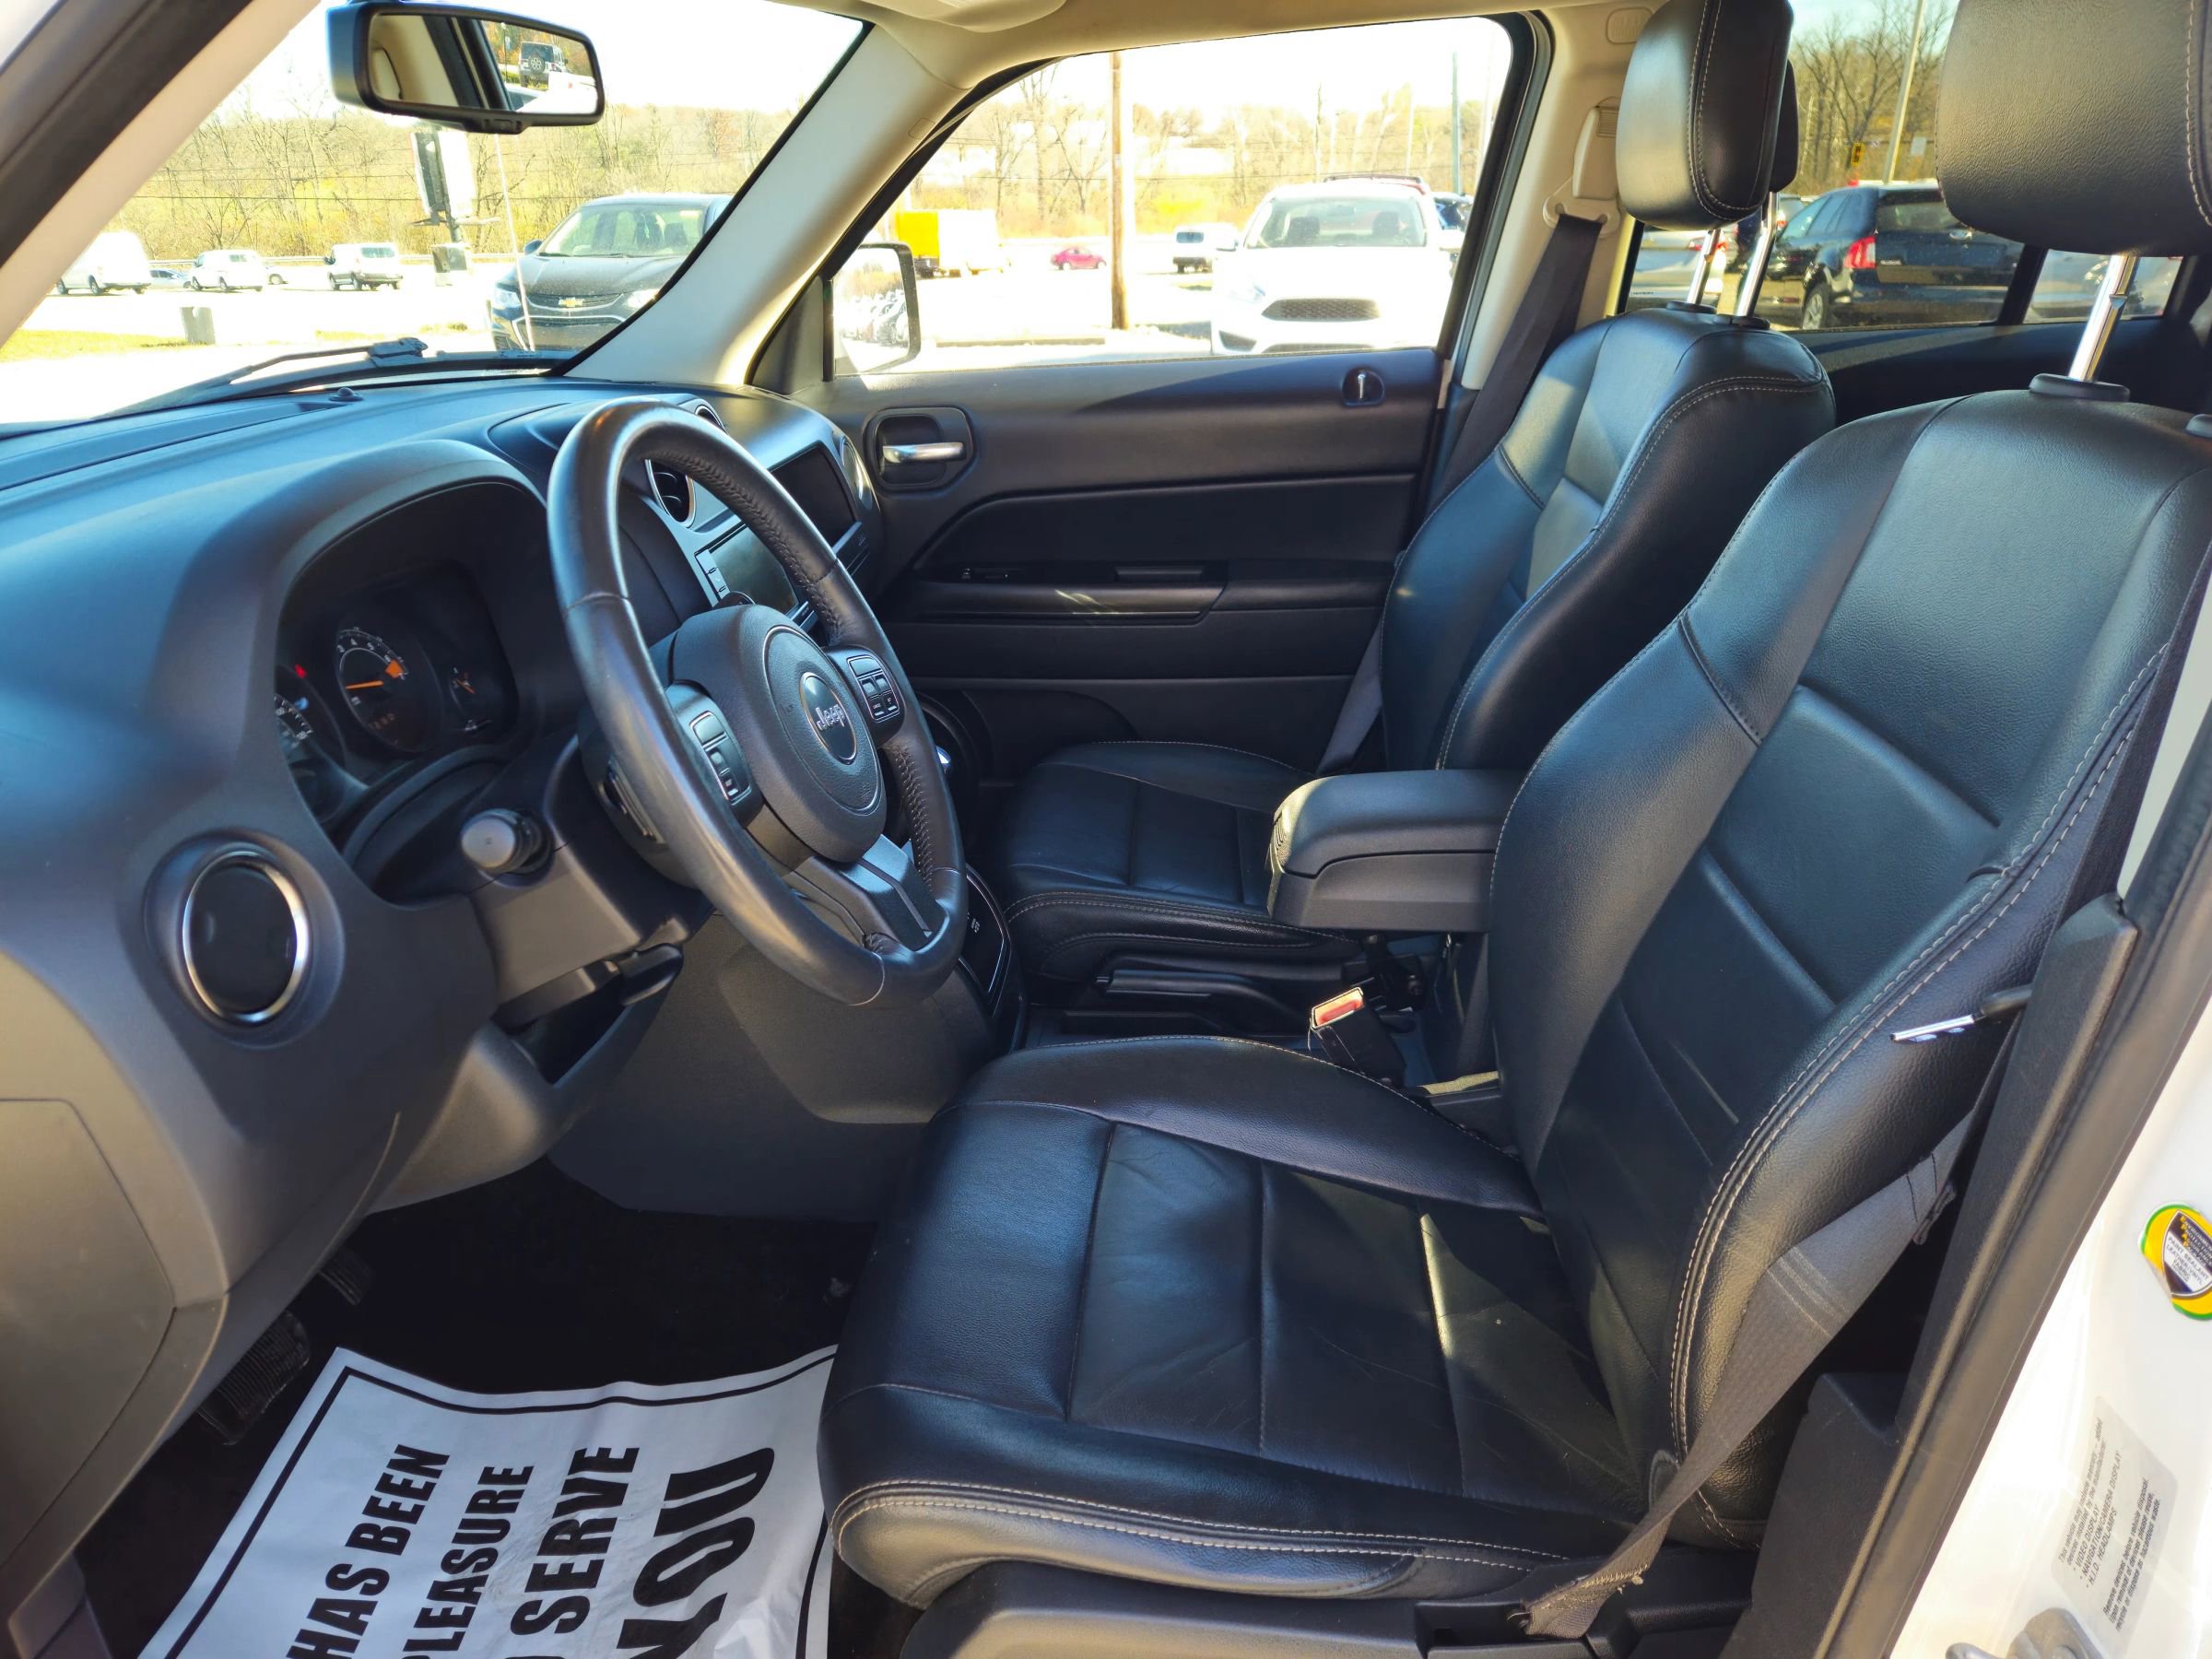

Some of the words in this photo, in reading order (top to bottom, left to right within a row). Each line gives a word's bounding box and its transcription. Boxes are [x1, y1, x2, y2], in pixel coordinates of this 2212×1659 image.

[816, 704, 846, 731] Jeep
[286, 1563, 391, 1659] HAS
[344, 1443, 451, 1557] BEEN
[402, 1465, 535, 1659] LEASURE
[510, 1447, 641, 1636] SERVE
[2058, 1547, 2067, 1562] This
[2075, 1540, 2088, 1567] VIDEO
[2084, 1504, 2100, 1542] DISPLAY
[2082, 1489, 2112, 1576] NAVIGATION/CAMERA
[2109, 1450, 2121, 1488] DISPLAY
[2088, 1561, 2100, 1585] H.I.D.
[2097, 1507, 2116, 1559] HEADLAMPS
